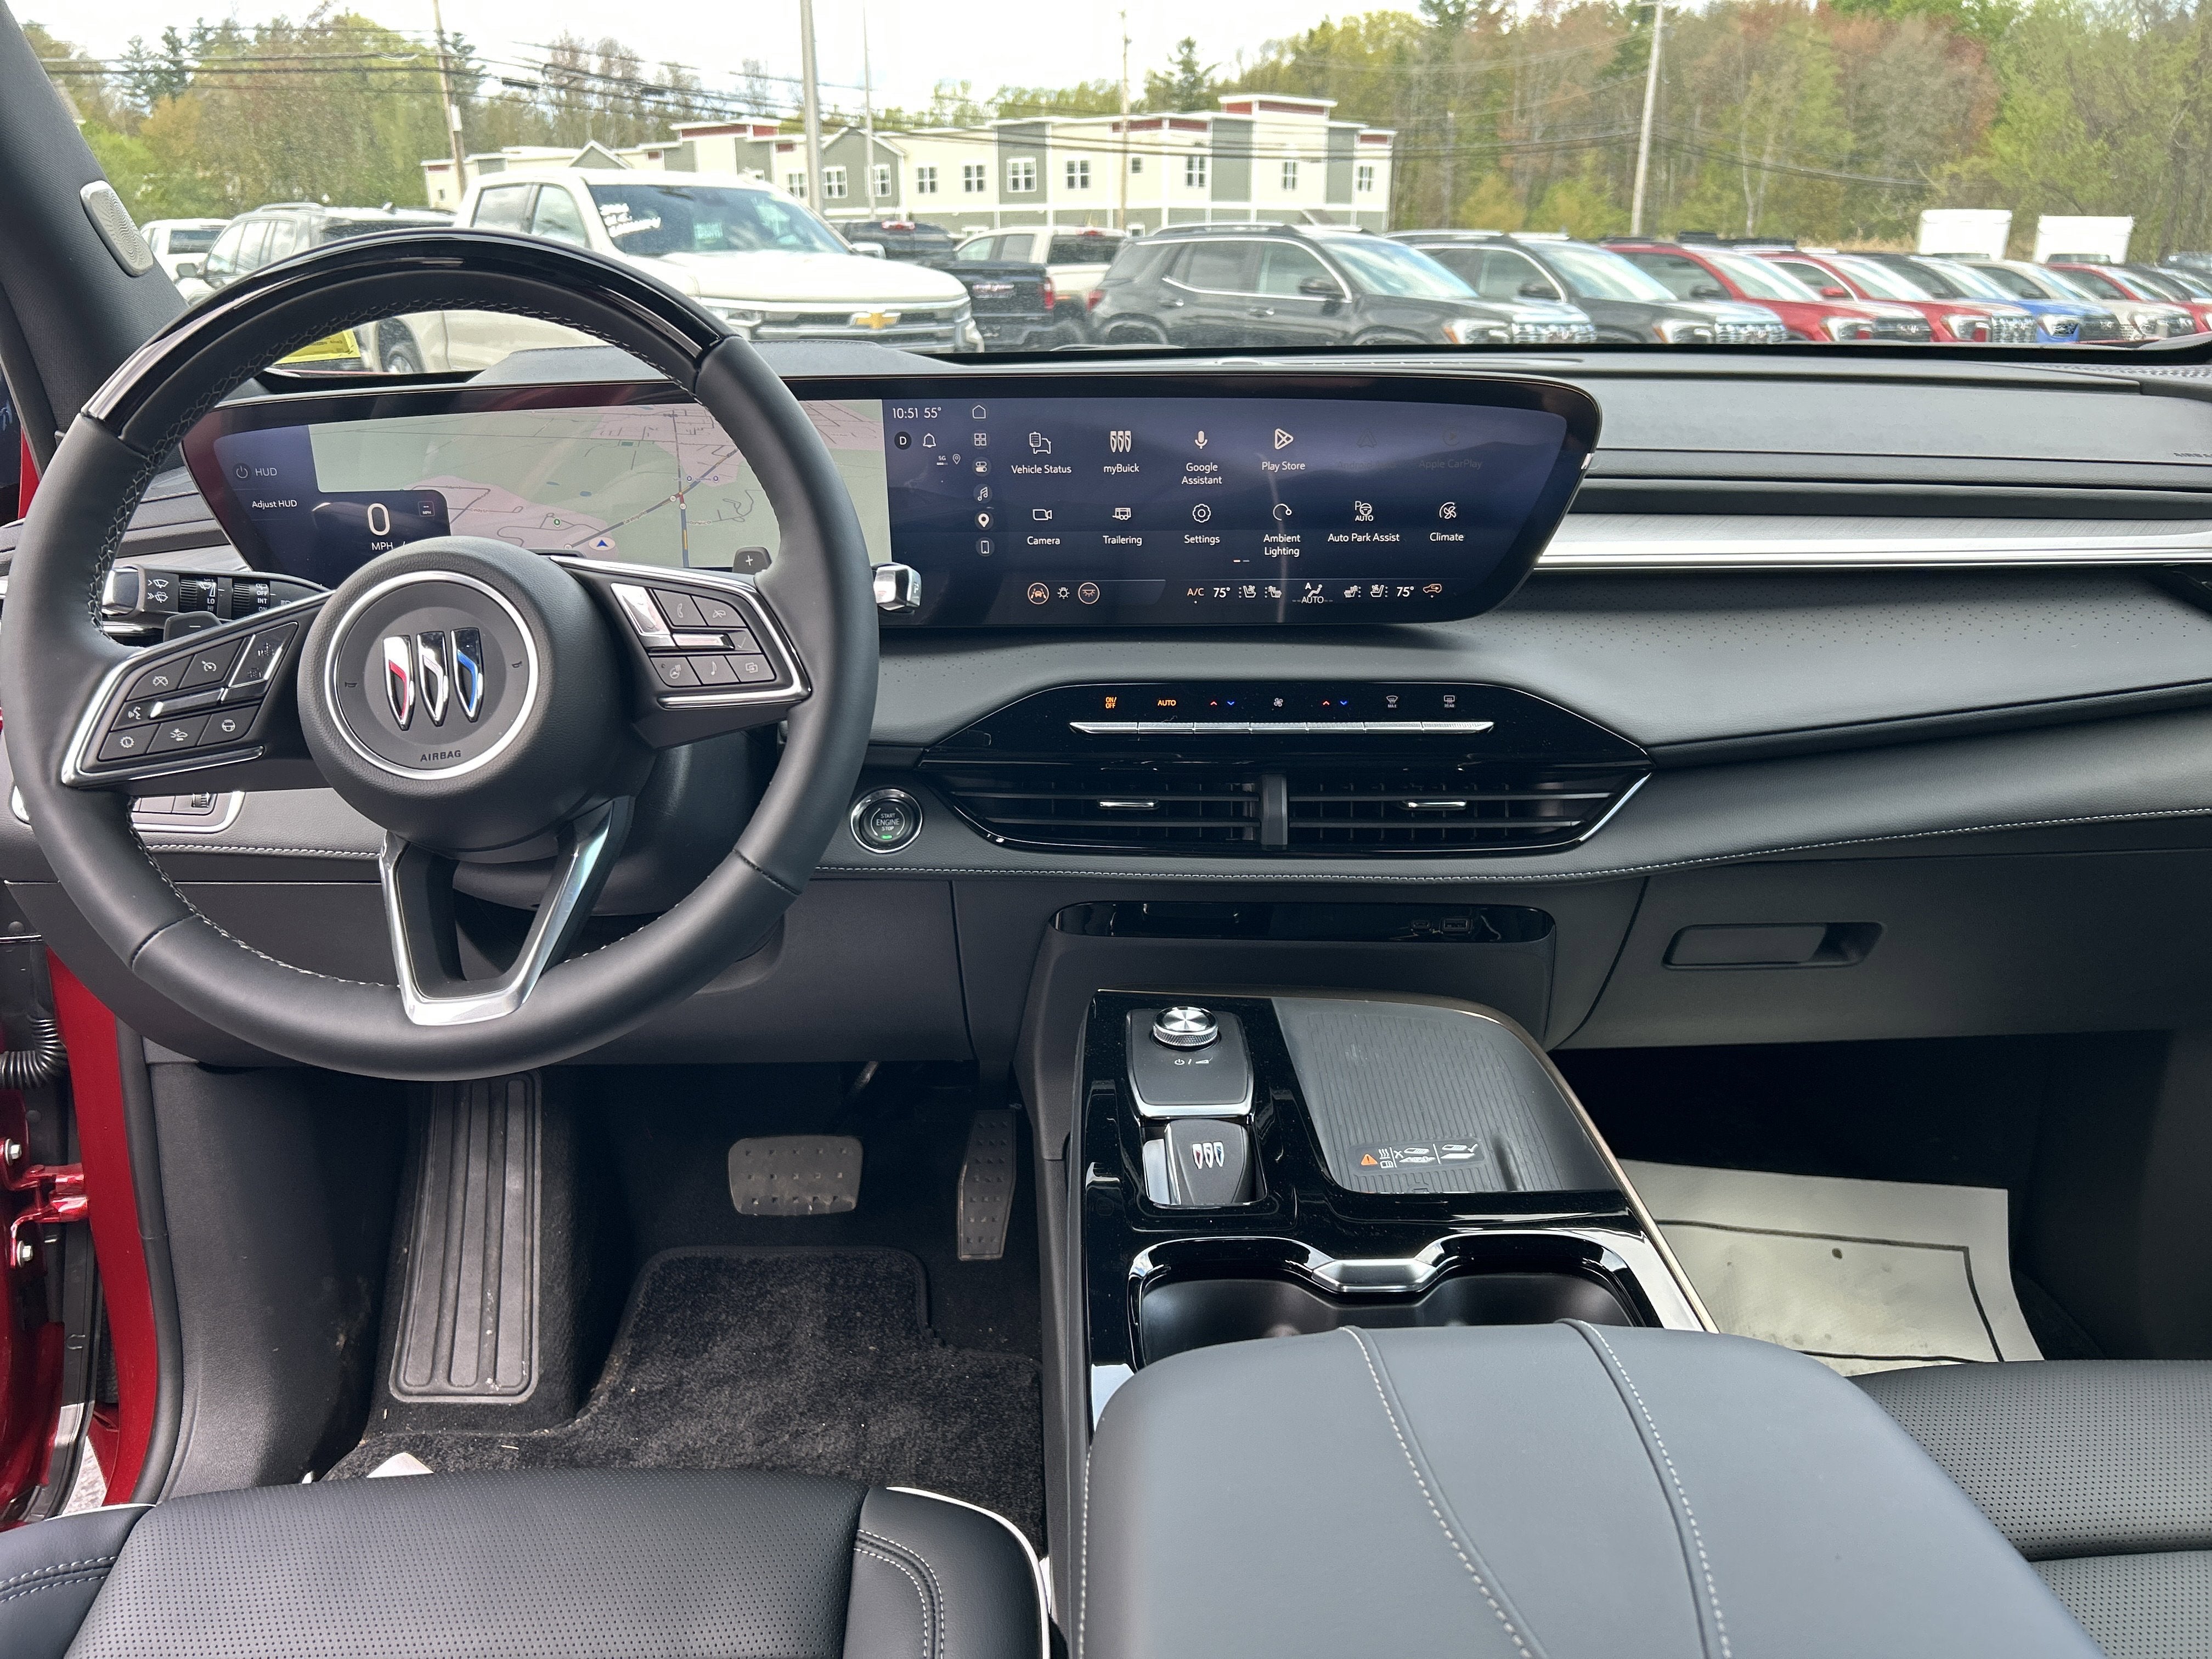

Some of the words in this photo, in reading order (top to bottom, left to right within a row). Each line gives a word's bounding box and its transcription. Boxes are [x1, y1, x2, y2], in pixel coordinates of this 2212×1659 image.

[893, 408, 918, 419] 10:51
[924, 407, 941, 419] 55°
[900, 436, 907, 445] D
[1011, 464, 1042, 474] Vehicle
[1044, 464, 1072, 474] Status
[1103, 462, 1139, 475] myBuick
[1186, 462, 1218, 474] Google
[1262, 461, 1280, 472] Play
[1282, 461, 1306, 471] Store
[1418, 460, 1445, 470] Apple
[1448, 459, 1482, 470] CarPlay
[255, 467, 278, 476] HUD
[1181, 476, 1222, 484] Assistant
[252, 500, 277, 509] Adjust
[278, 499, 297, 507] HUD
[367, 503, 390, 536] 0
[1027, 536, 1060, 545] Camera
[1103, 535, 1142, 546] Trailering
[1184, 534, 1220, 546] Settings
[1263, 533, 1301, 543] Ambient
[1327, 533, 1349, 542] Auto
[1351, 533, 1371, 542] Park
[1372, 533, 1400, 542] Assist
[1430, 532, 1464, 542] Climate
[371, 541, 393, 551] MPH
[1264, 546, 1300, 558] Lighting
[1187, 588, 1204, 596] A/C
[1213, 587, 1231, 598] 75°
[1396, 586, 1414, 597] 75°
[420, 750, 461, 762] AIRBAG
[876, 818, 900, 826] ENGINE
